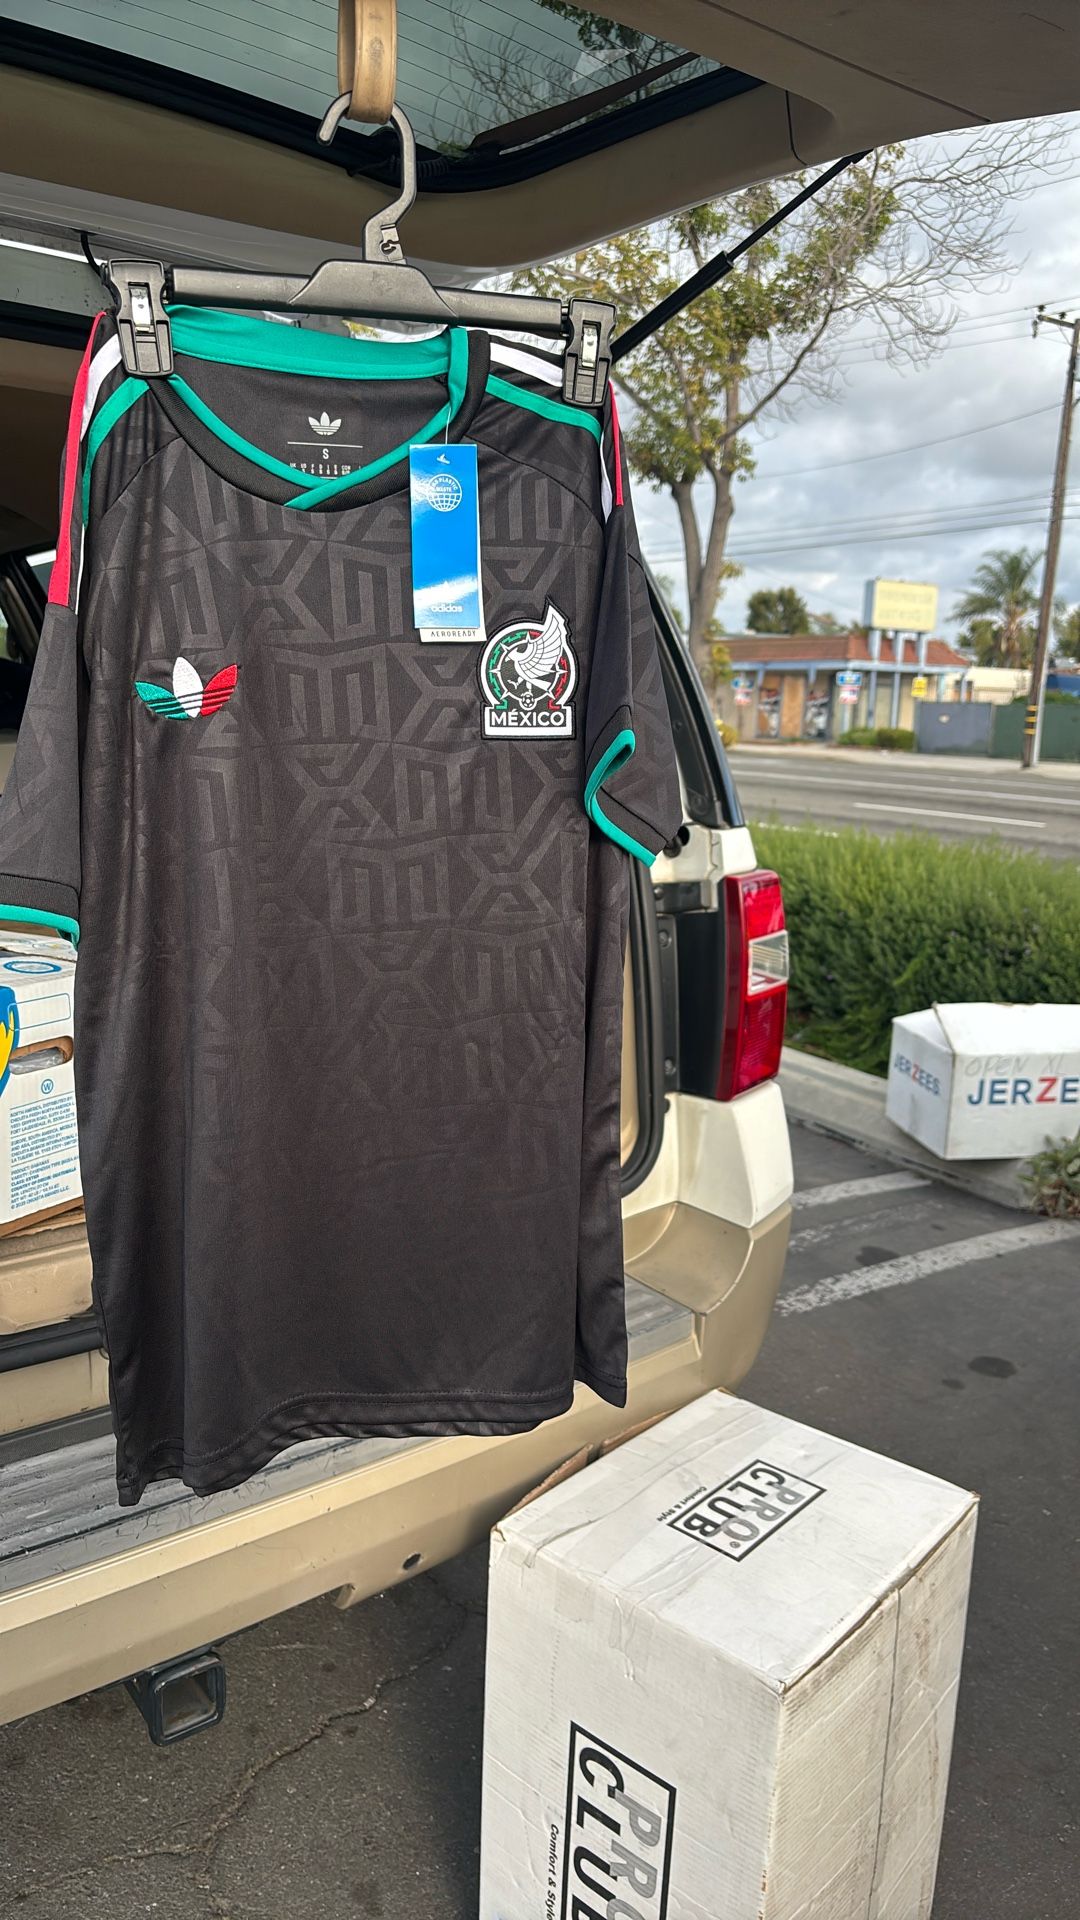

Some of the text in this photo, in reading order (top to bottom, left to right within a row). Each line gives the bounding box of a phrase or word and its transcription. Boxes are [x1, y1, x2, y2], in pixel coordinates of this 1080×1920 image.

[322, 448, 330, 460] S
[439, 477, 458, 490] PLASTIC
[431, 604, 463, 613] adidas
[430, 630, 476, 638] AEROREADY
[491, 708, 565, 726] MÉXICO
[894, 1053, 941, 1097] JERZEES
[683, 1467, 785, 1538] CLUB
[719, 1482, 806, 1542] PRO
[549, 1823, 560, 1878] Comfort
[548, 1878, 557, 1888] &
